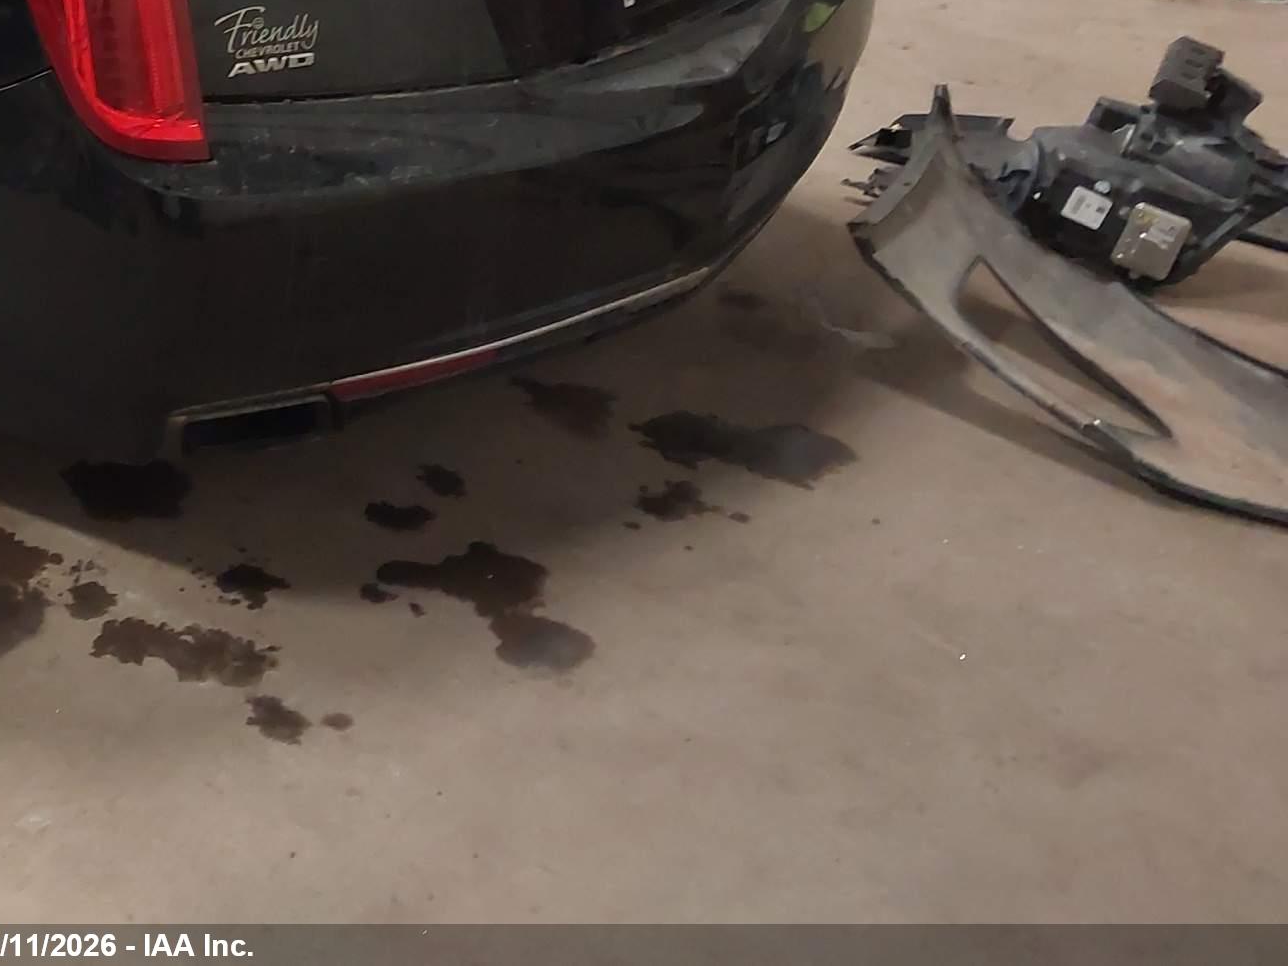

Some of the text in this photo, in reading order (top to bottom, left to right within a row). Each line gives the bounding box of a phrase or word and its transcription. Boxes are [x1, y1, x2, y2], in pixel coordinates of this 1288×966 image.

[214, 6, 319, 53] Friendly
[235, 41, 300, 59] CHEVROLET
[228, 52, 315, 78] AWD
